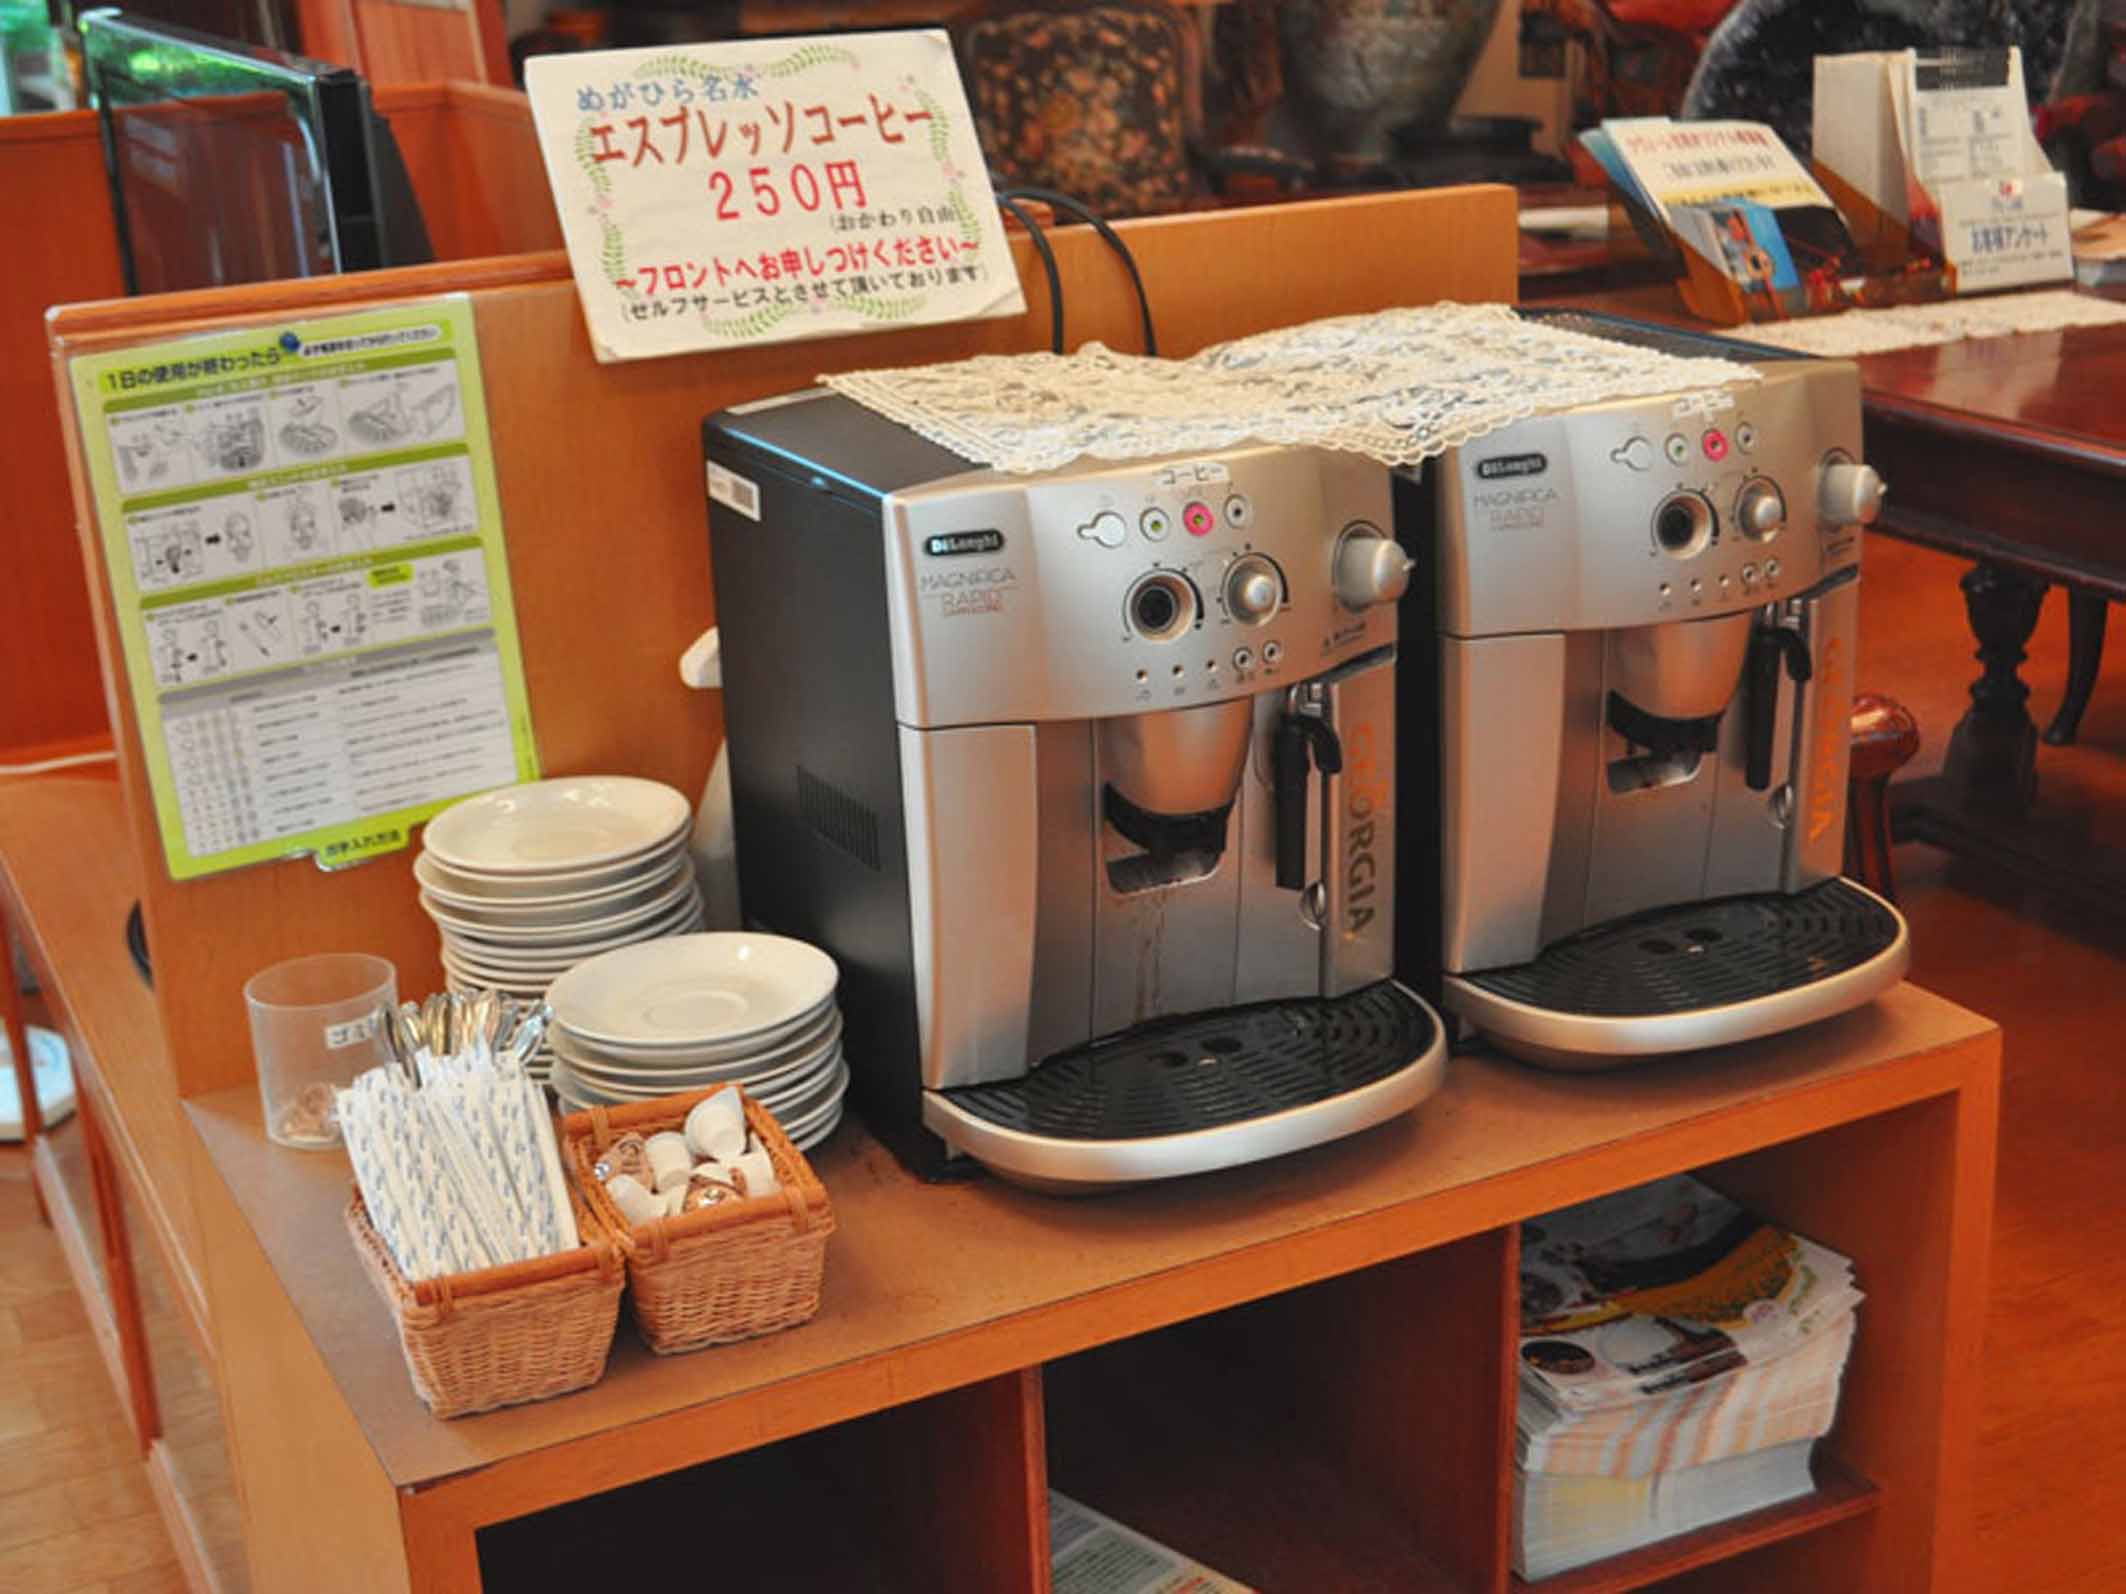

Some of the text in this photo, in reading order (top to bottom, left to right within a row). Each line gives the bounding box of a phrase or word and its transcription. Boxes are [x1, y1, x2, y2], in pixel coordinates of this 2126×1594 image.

[577, 75, 758, 110] めがひら名水
[589, 93, 933, 167] エスプレッソコーヒー
[708, 160, 867, 221] 250円
